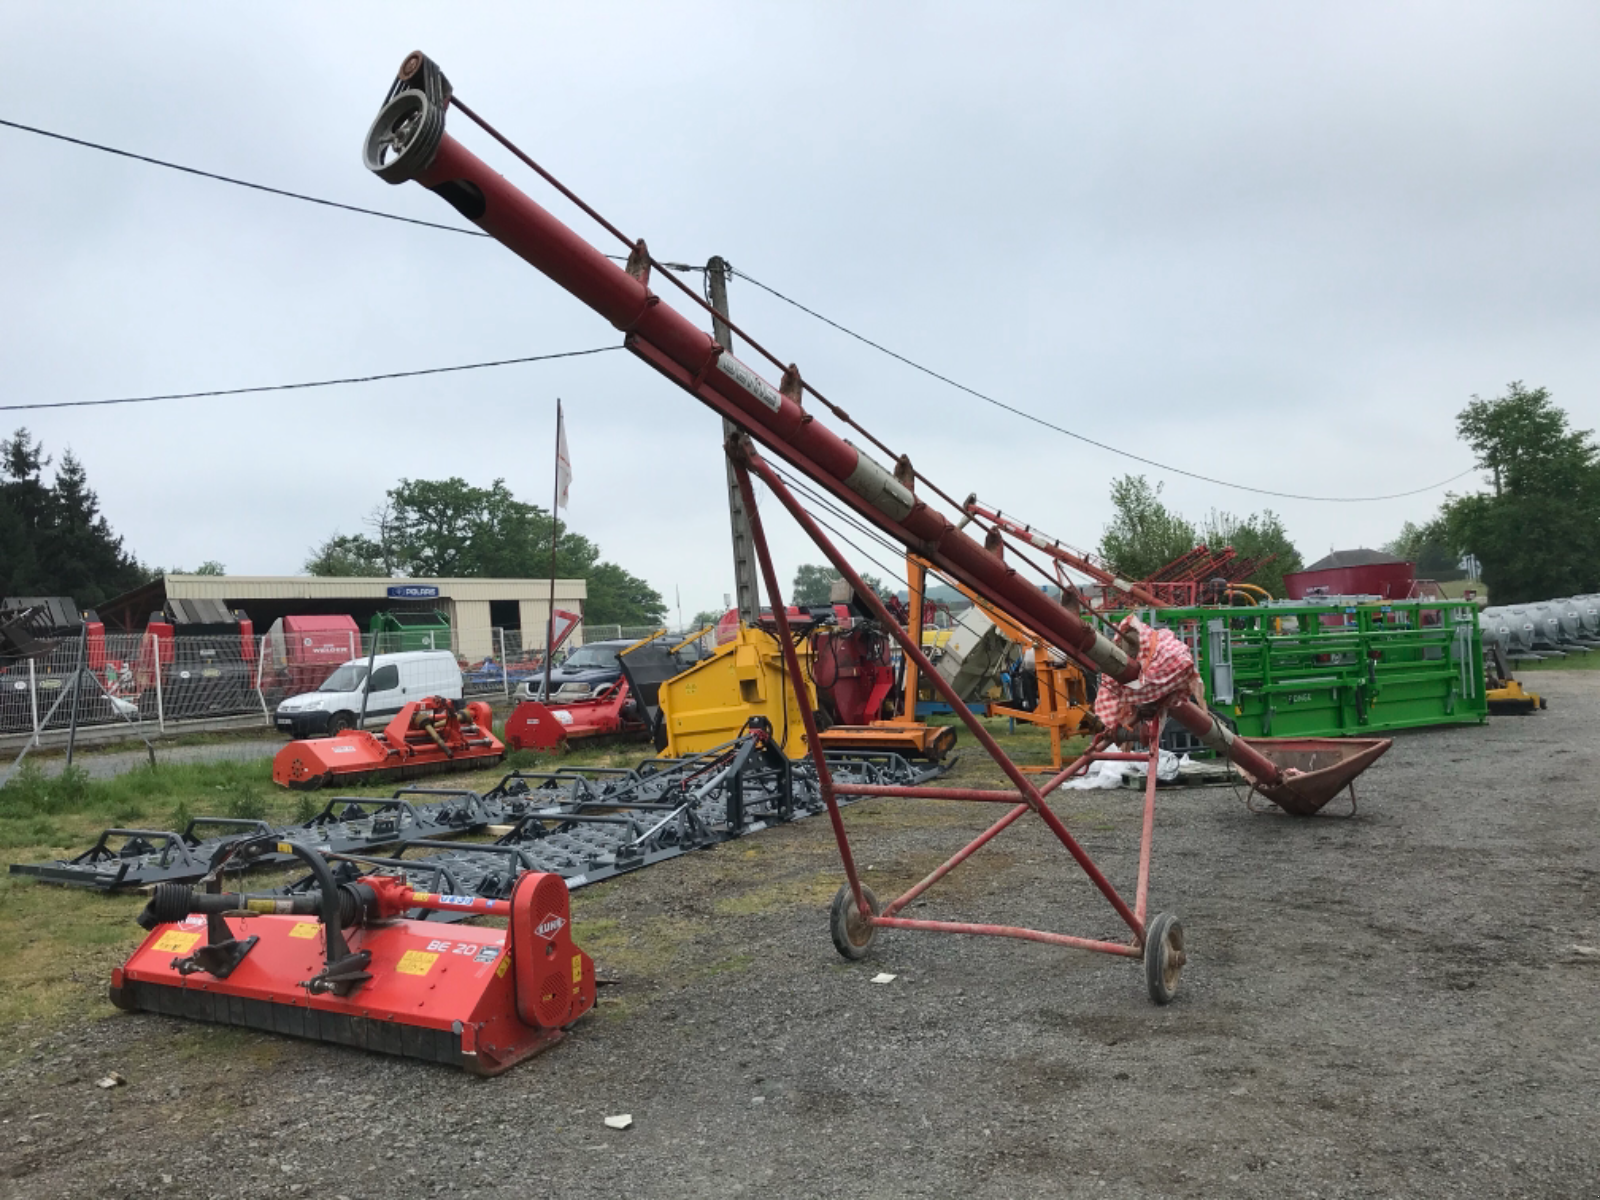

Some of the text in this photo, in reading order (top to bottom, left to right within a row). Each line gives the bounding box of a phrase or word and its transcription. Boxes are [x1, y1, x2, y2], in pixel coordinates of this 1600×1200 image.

[405, 588, 436, 596] POLARIS
[536, 916, 563, 935] KUHN
[426, 940, 451, 953] BE
[452, 943, 477, 956] 20
